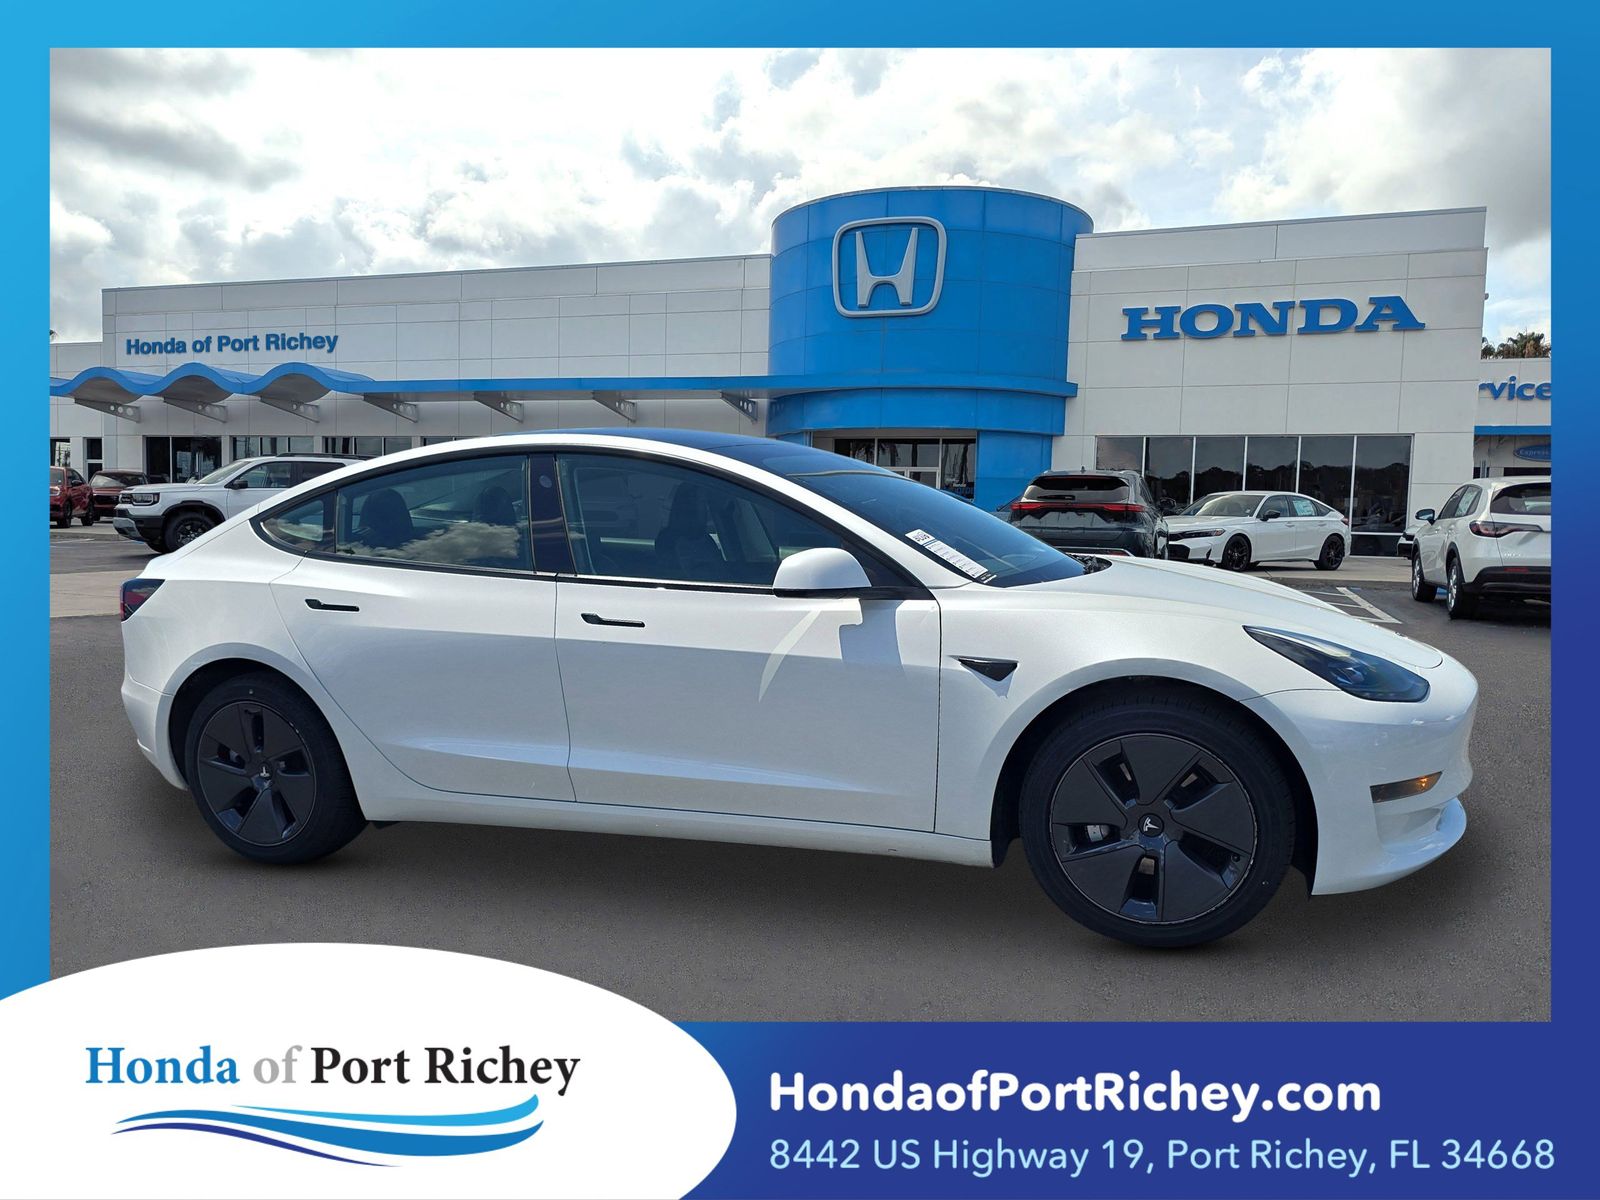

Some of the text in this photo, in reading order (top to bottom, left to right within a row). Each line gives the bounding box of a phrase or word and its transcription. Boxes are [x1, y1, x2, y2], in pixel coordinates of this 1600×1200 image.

[1121, 295, 1426, 341] HONDA
[125, 331, 339, 355] Honda of Port Richey
